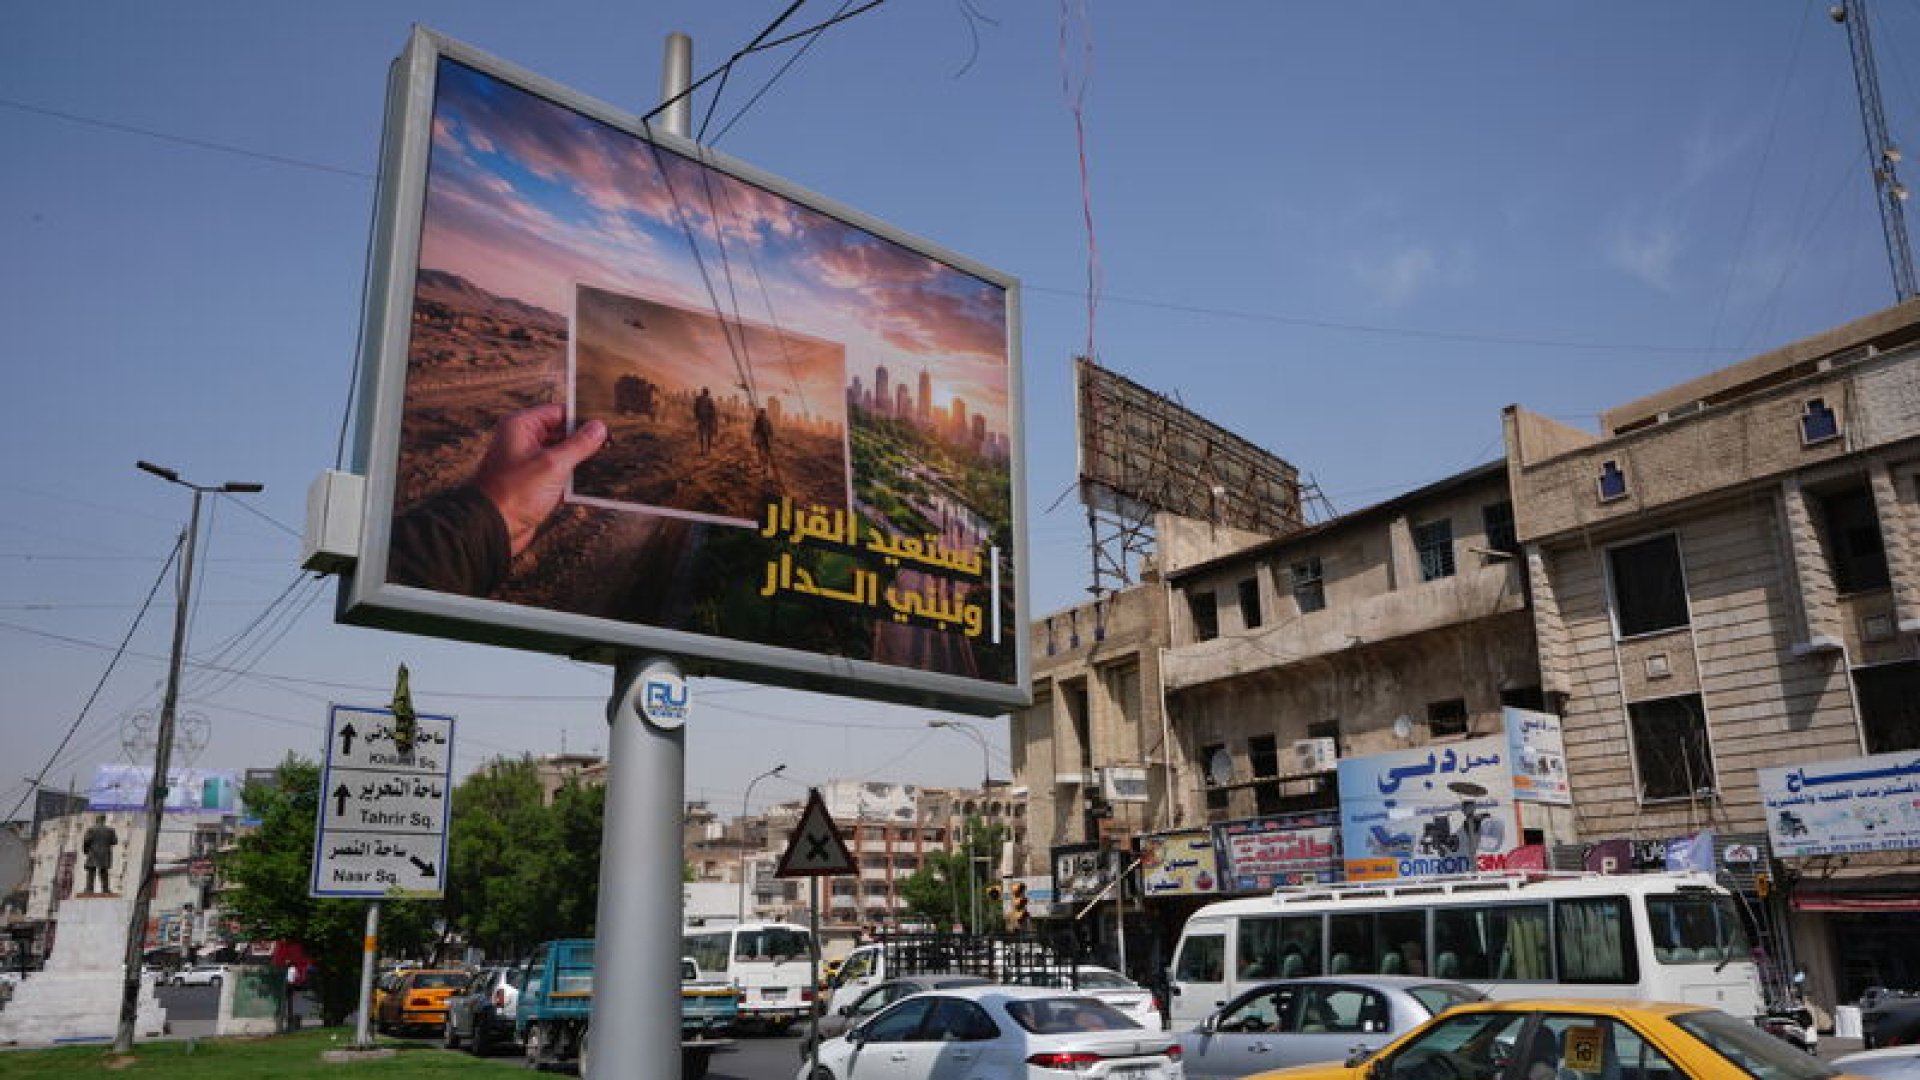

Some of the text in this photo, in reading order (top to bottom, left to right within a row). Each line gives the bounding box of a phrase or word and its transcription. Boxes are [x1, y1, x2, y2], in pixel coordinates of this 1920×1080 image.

[761, 497, 984, 576] نستعيد القرار
[761, 552, 982, 637] ونبني الدار
[359, 776, 443, 801] ساحة التحرير
[1377, 748, 1458, 808] دبي
[360, 808, 435, 829] Tahrir Sq.
[328, 839, 406, 860] ساحة النصر
[333, 868, 372, 883] Nasr
